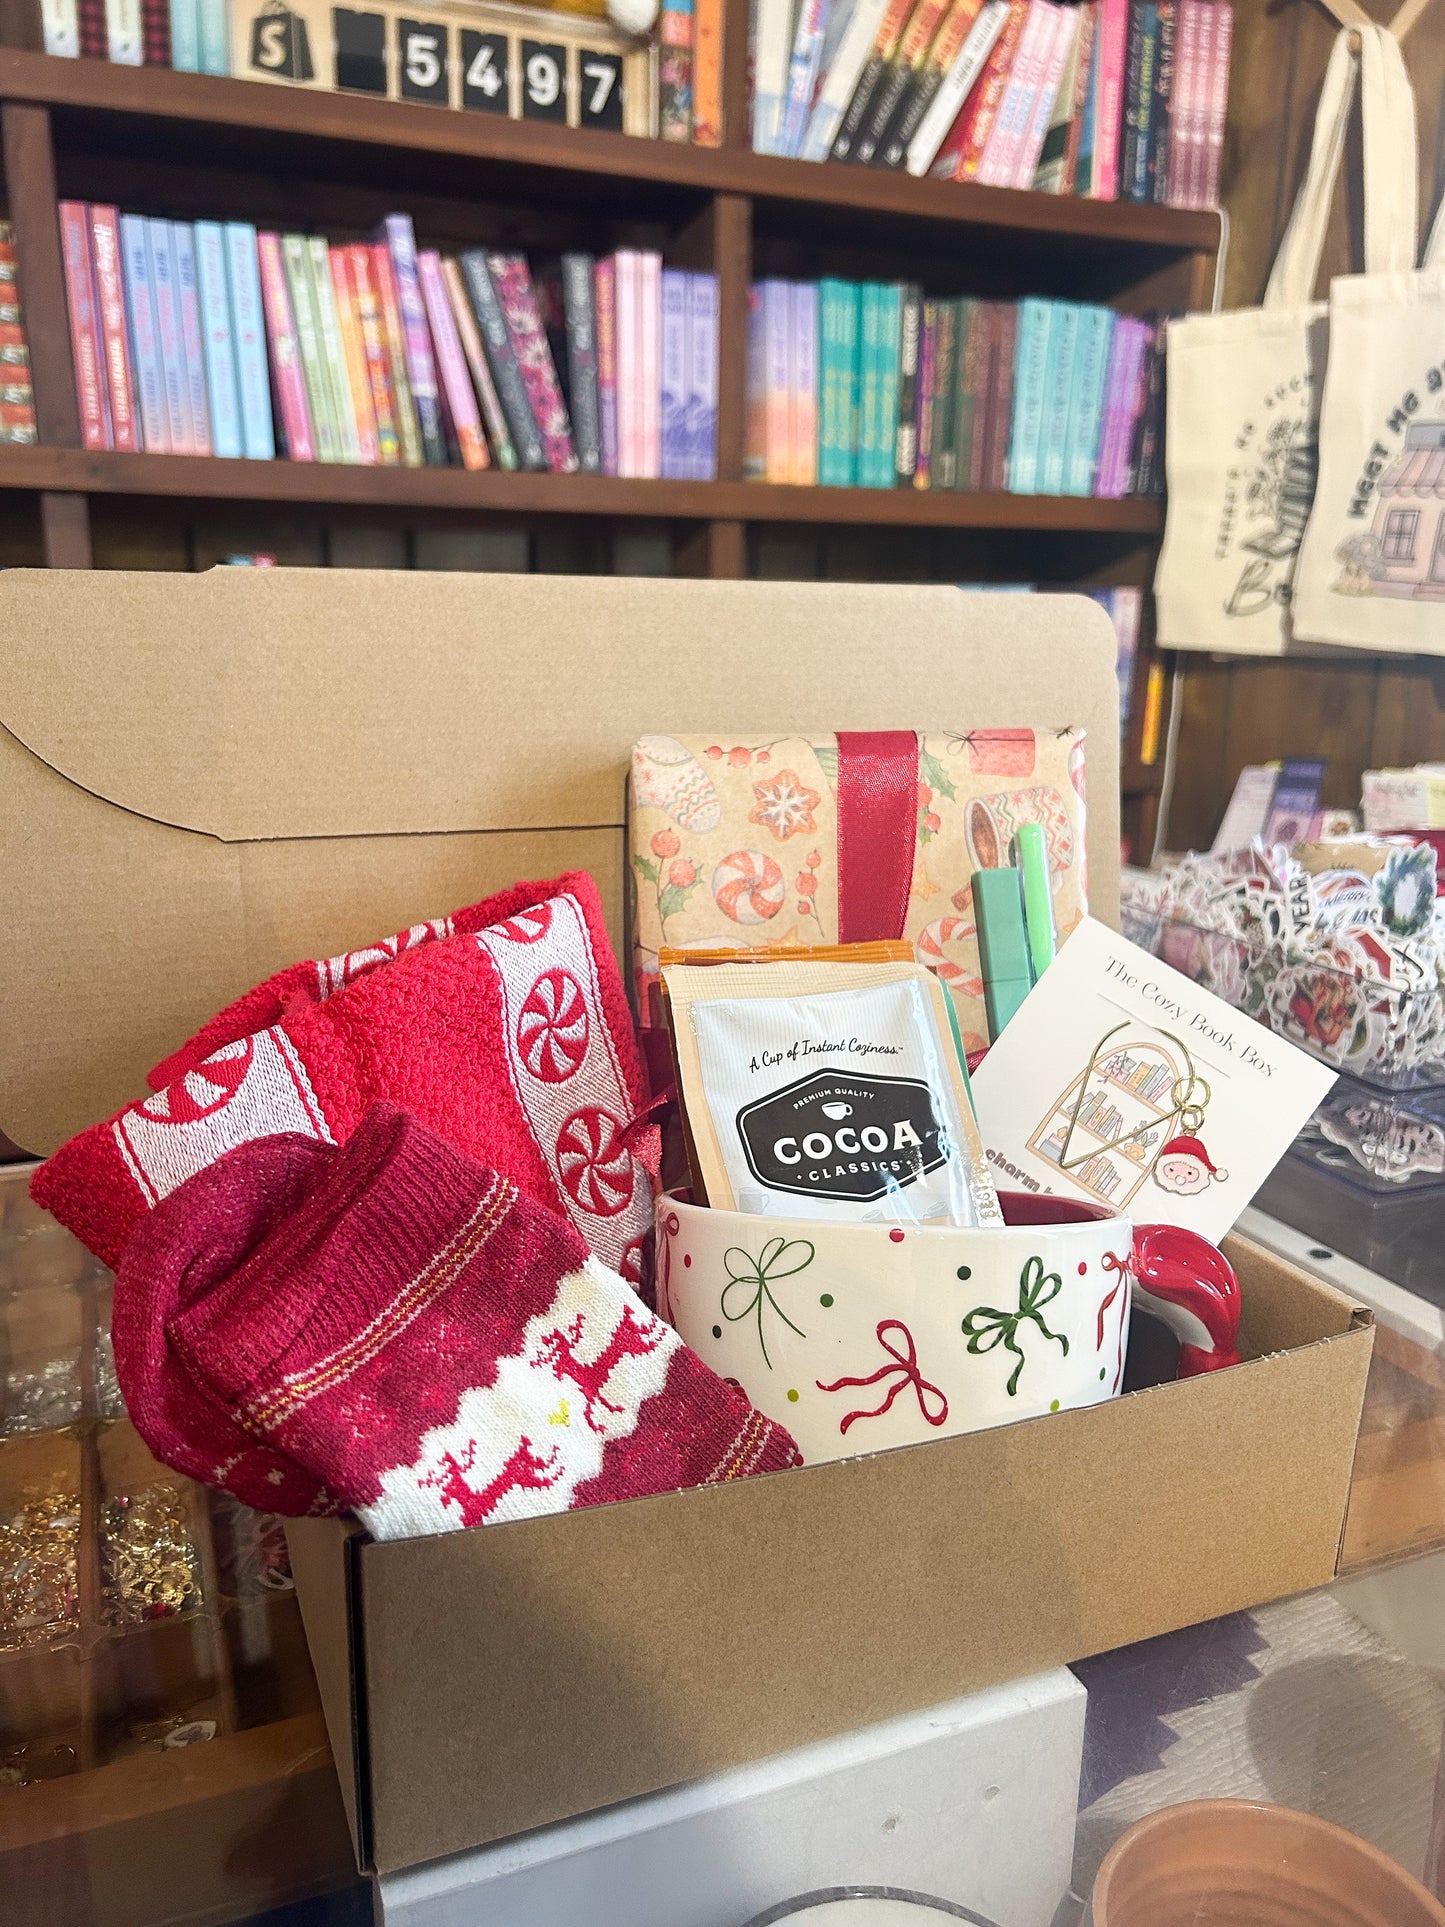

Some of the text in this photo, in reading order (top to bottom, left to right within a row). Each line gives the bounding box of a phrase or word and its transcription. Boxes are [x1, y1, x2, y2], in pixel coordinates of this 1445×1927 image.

[1289, 876, 1311, 935] YEAR
[1104, 955, 1278, 1077] The Cozy Book Box
[749, 1056, 760, 1073] A
[762, 1050, 783, 1067] Cup
[786, 1041, 799, 1061] of
[801, 1039, 846, 1056] Instant
[792, 1087, 875, 1110] PREMIUM QUALITY
[773, 1119, 924, 1165] COCOA
[808, 1160, 901, 1182] CLASSICS
[985, 1148, 1041, 1193] charm
